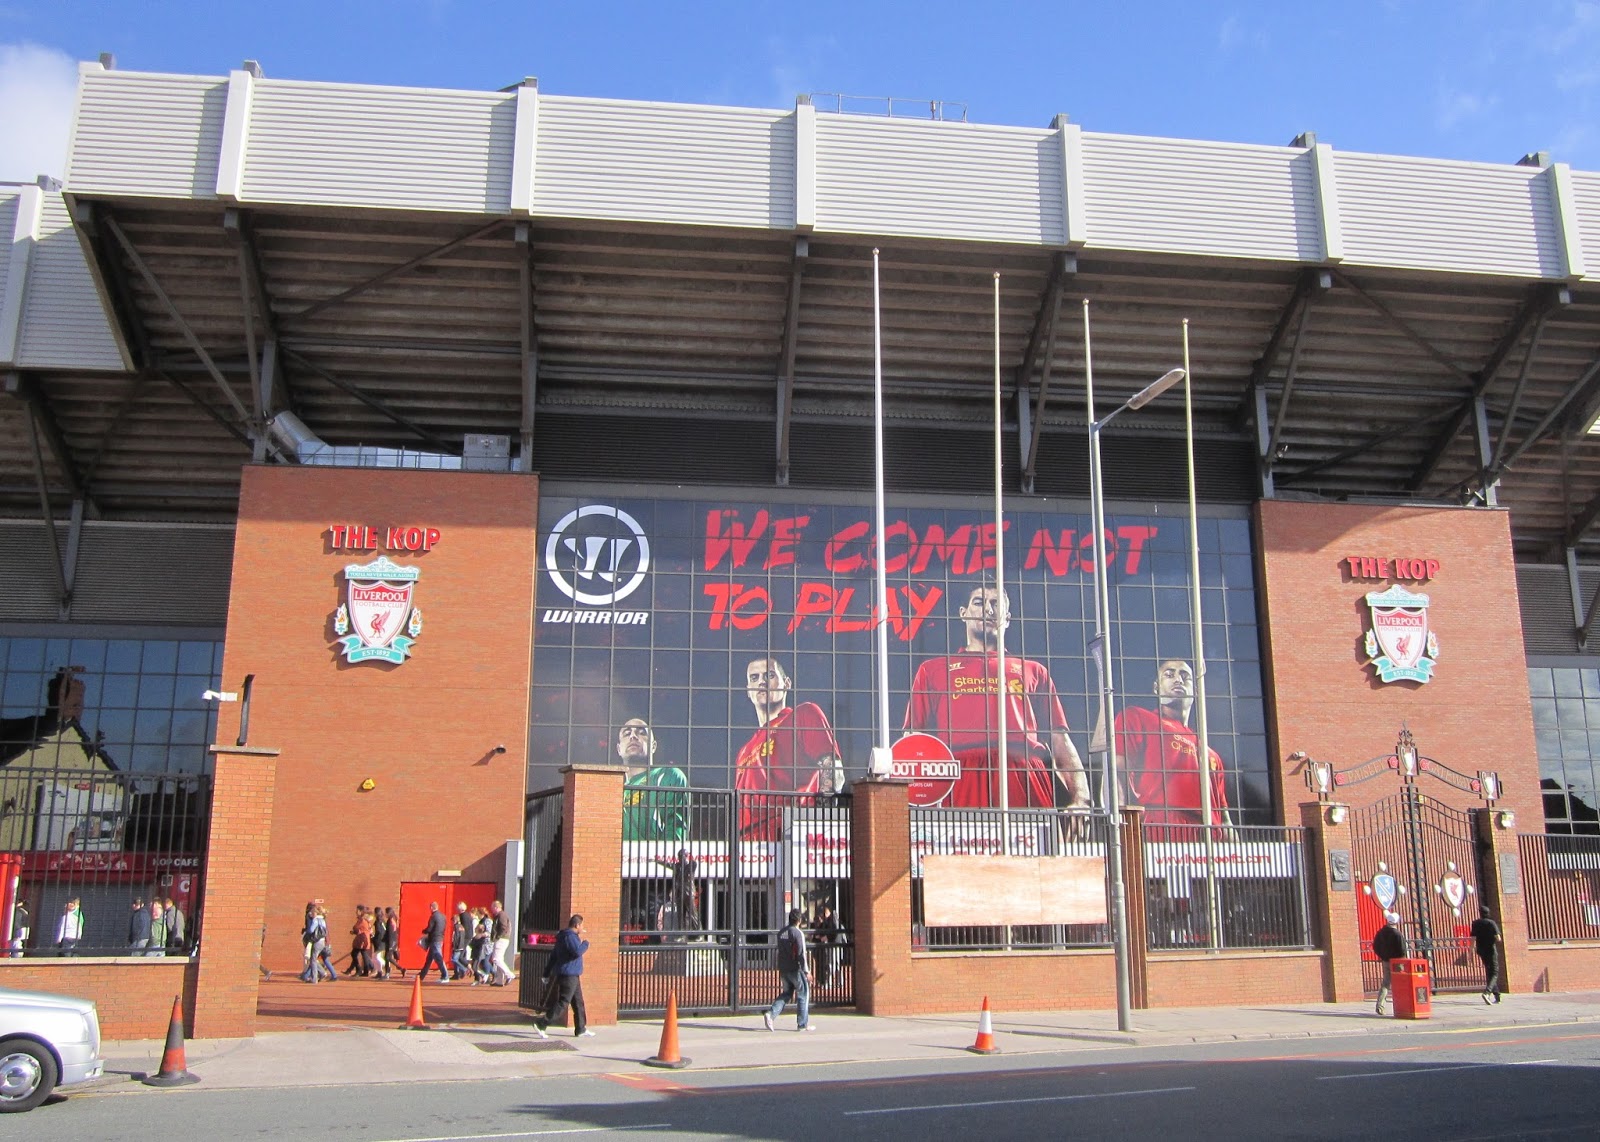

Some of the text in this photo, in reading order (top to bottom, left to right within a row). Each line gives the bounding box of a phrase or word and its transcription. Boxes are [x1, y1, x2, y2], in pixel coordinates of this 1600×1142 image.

[330, 525, 441, 551] THE KOP
[705, 509, 1159, 577] WE COME NOT
[1347, 556, 1440, 580] THE KOP
[355, 591, 406, 601] LIVERPOOL
[542, 610, 649, 625] WARRIOR
[704, 583, 944, 641] TO PLAY
[1378, 616, 1422, 626] LIVERPOOL
[892, 762, 958, 776] OOT ROOM
[1347, 760, 1385, 782] PAISLEY
[806, 833, 850, 850] Mus
[817, 853, 852, 865] Tour
